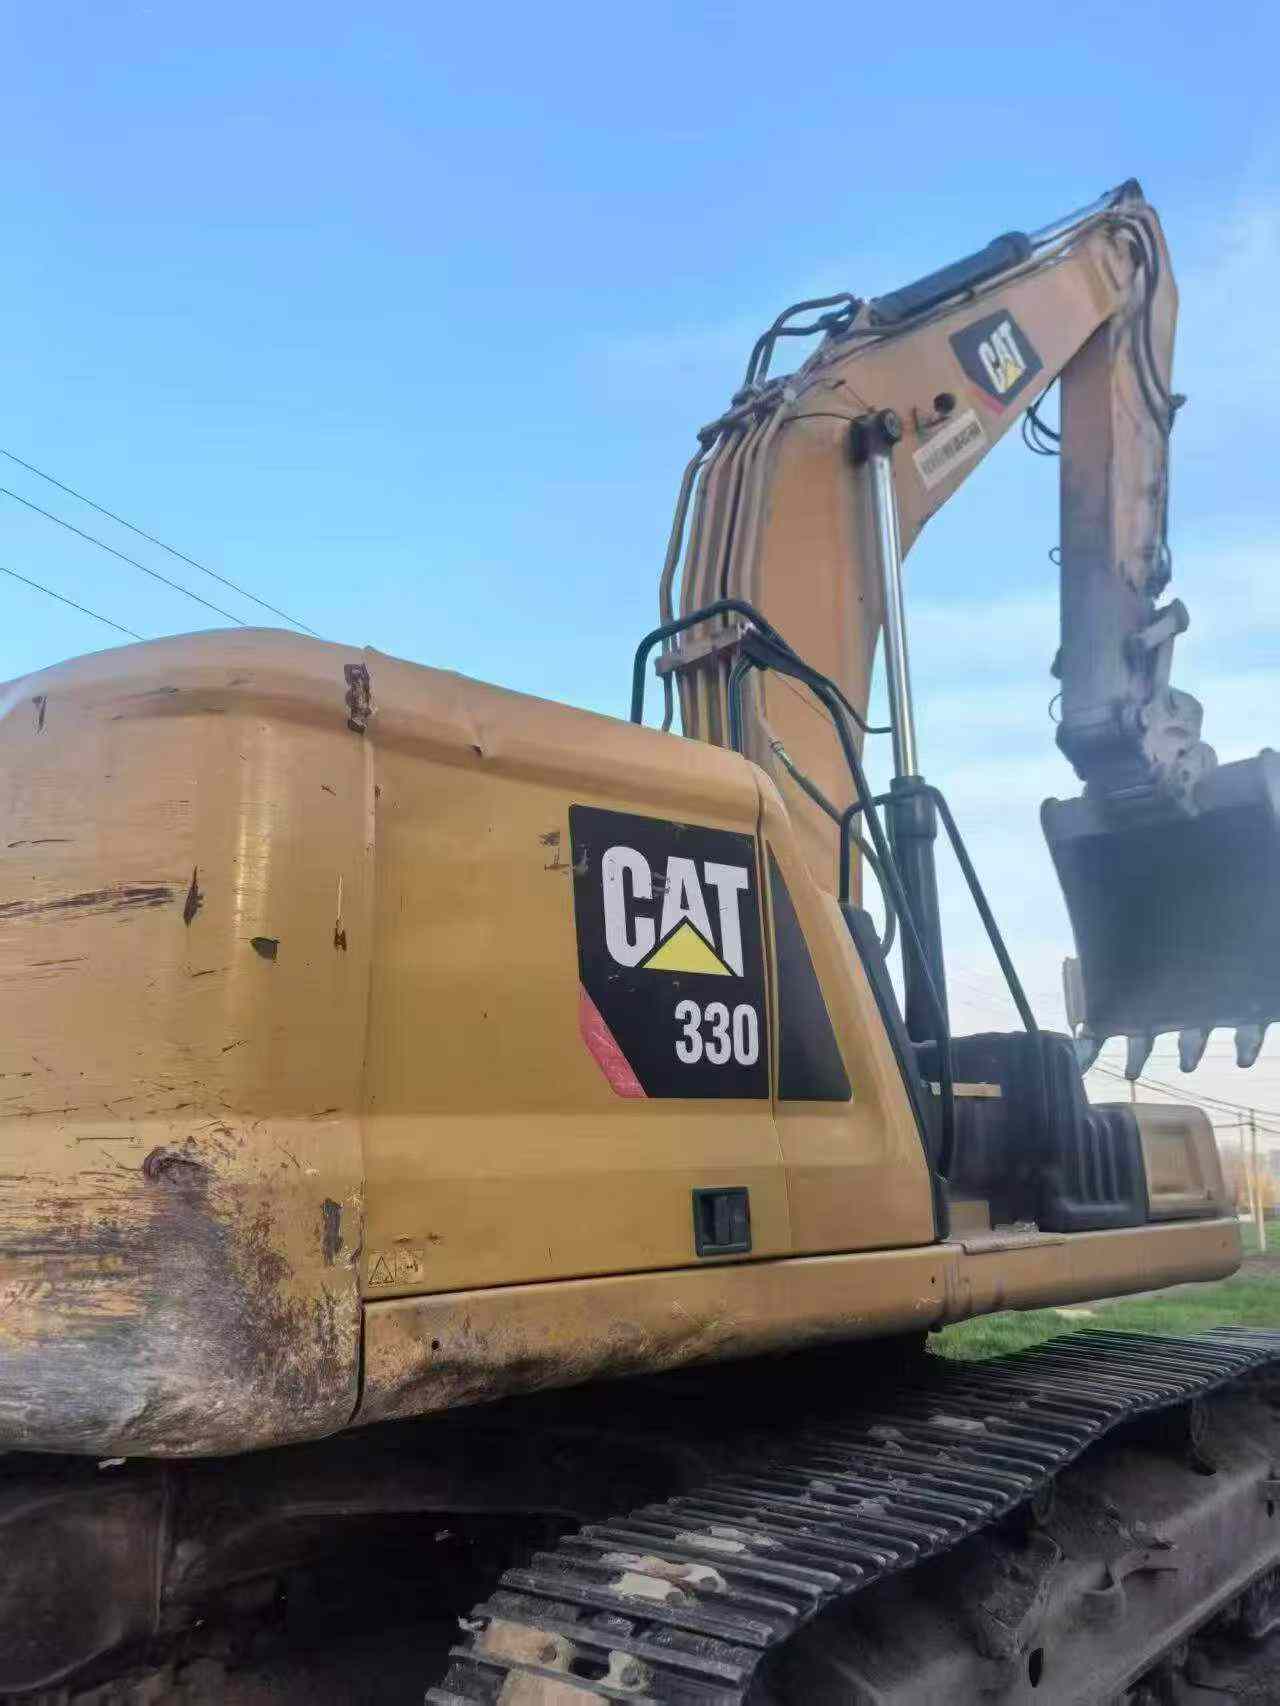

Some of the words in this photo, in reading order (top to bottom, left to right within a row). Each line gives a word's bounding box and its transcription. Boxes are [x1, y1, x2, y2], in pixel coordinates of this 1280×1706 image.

[978, 319, 1027, 394] CAT
[601, 845, 749, 978] CAT
[674, 999, 760, 1066] 330
